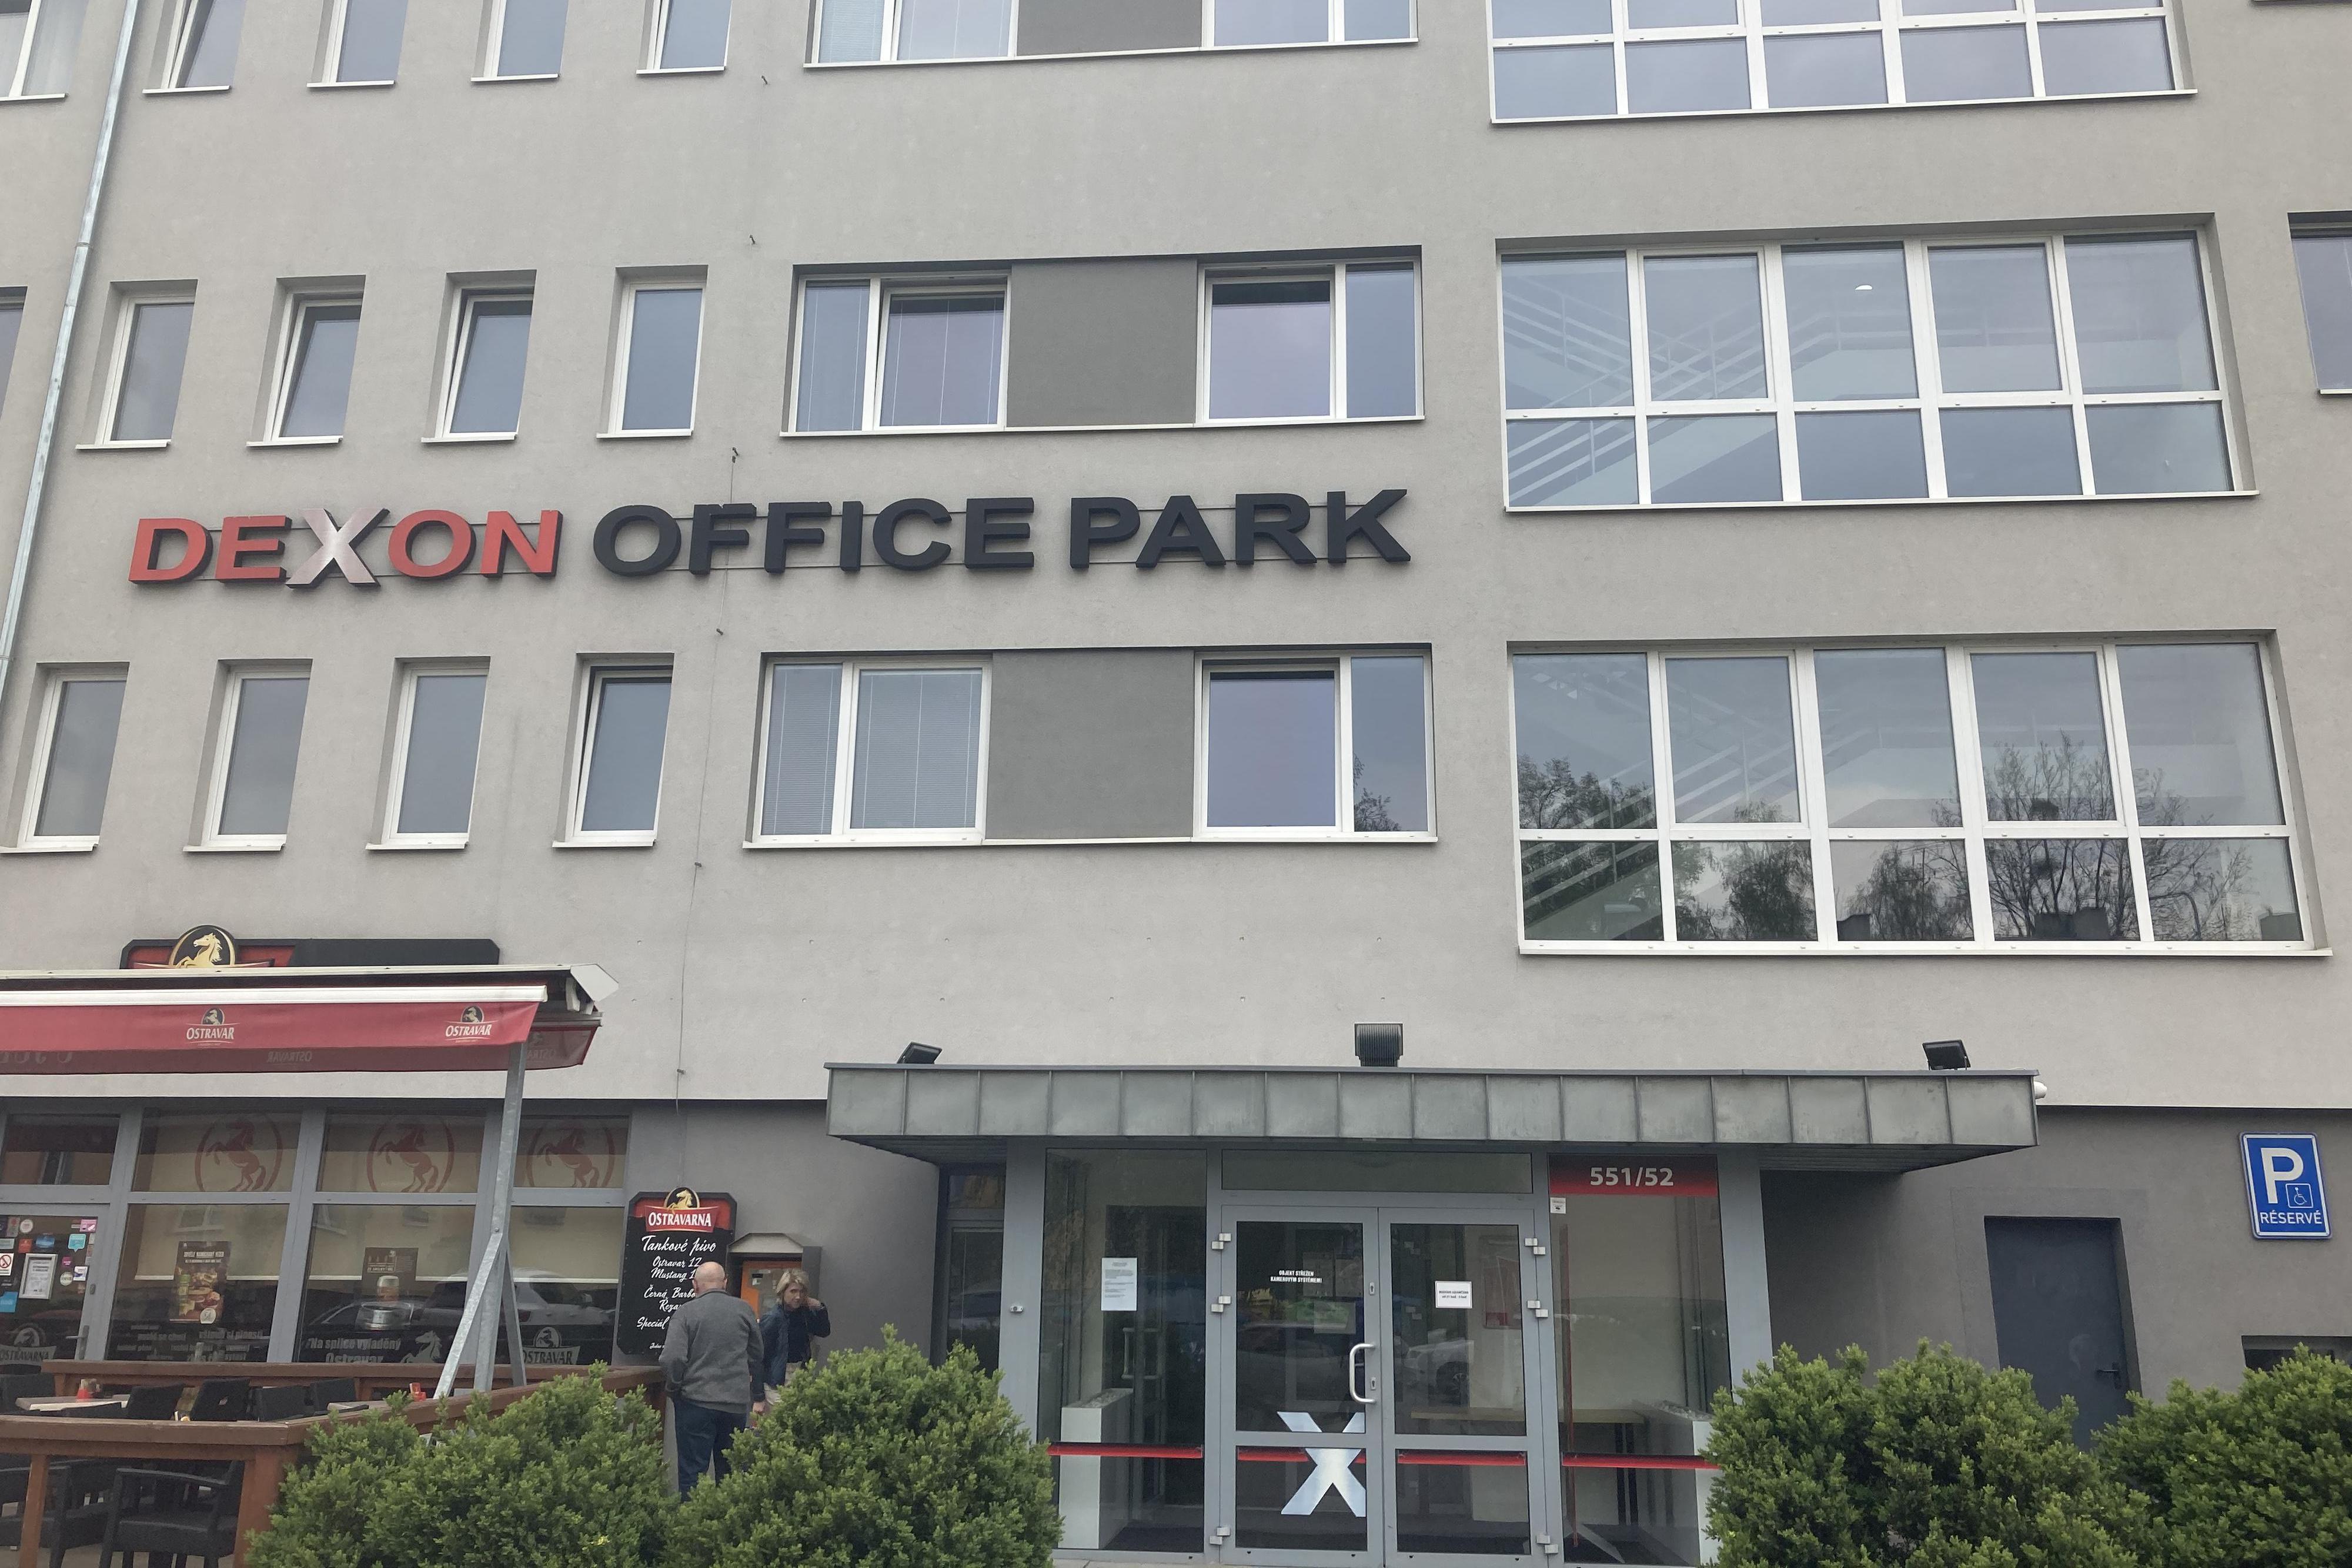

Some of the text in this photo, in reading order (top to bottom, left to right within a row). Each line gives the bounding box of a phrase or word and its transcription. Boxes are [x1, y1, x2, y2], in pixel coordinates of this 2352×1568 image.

[128, 489, 1411, 589] DEXON OFFICE PARK
[186, 1027, 235, 1040] OSTRAVAR
[445, 1024, 493, 1037] OSTRAVAR
[1589, 1166, 1674, 1187] 551/52
[2260, 1147, 2304, 1204] P
[648, 1212, 712, 1228] OSTRAVARNA
[2259, 1209, 2323, 1226] RÉSERVÉ
[641, 1235, 717, 1256] Tankové pivo
[652, 1255, 687, 1268] Ostravar
[650, 1266, 688, 1282] Mustang
[671, 1287, 696, 1298] Barbo
[659, 1297, 682, 1313] Řeza
[636, 1316, 670, 1330] Speciál
[310, 1338, 323, 1349] Na
[356, 1337, 401, 1351] vyladěný
